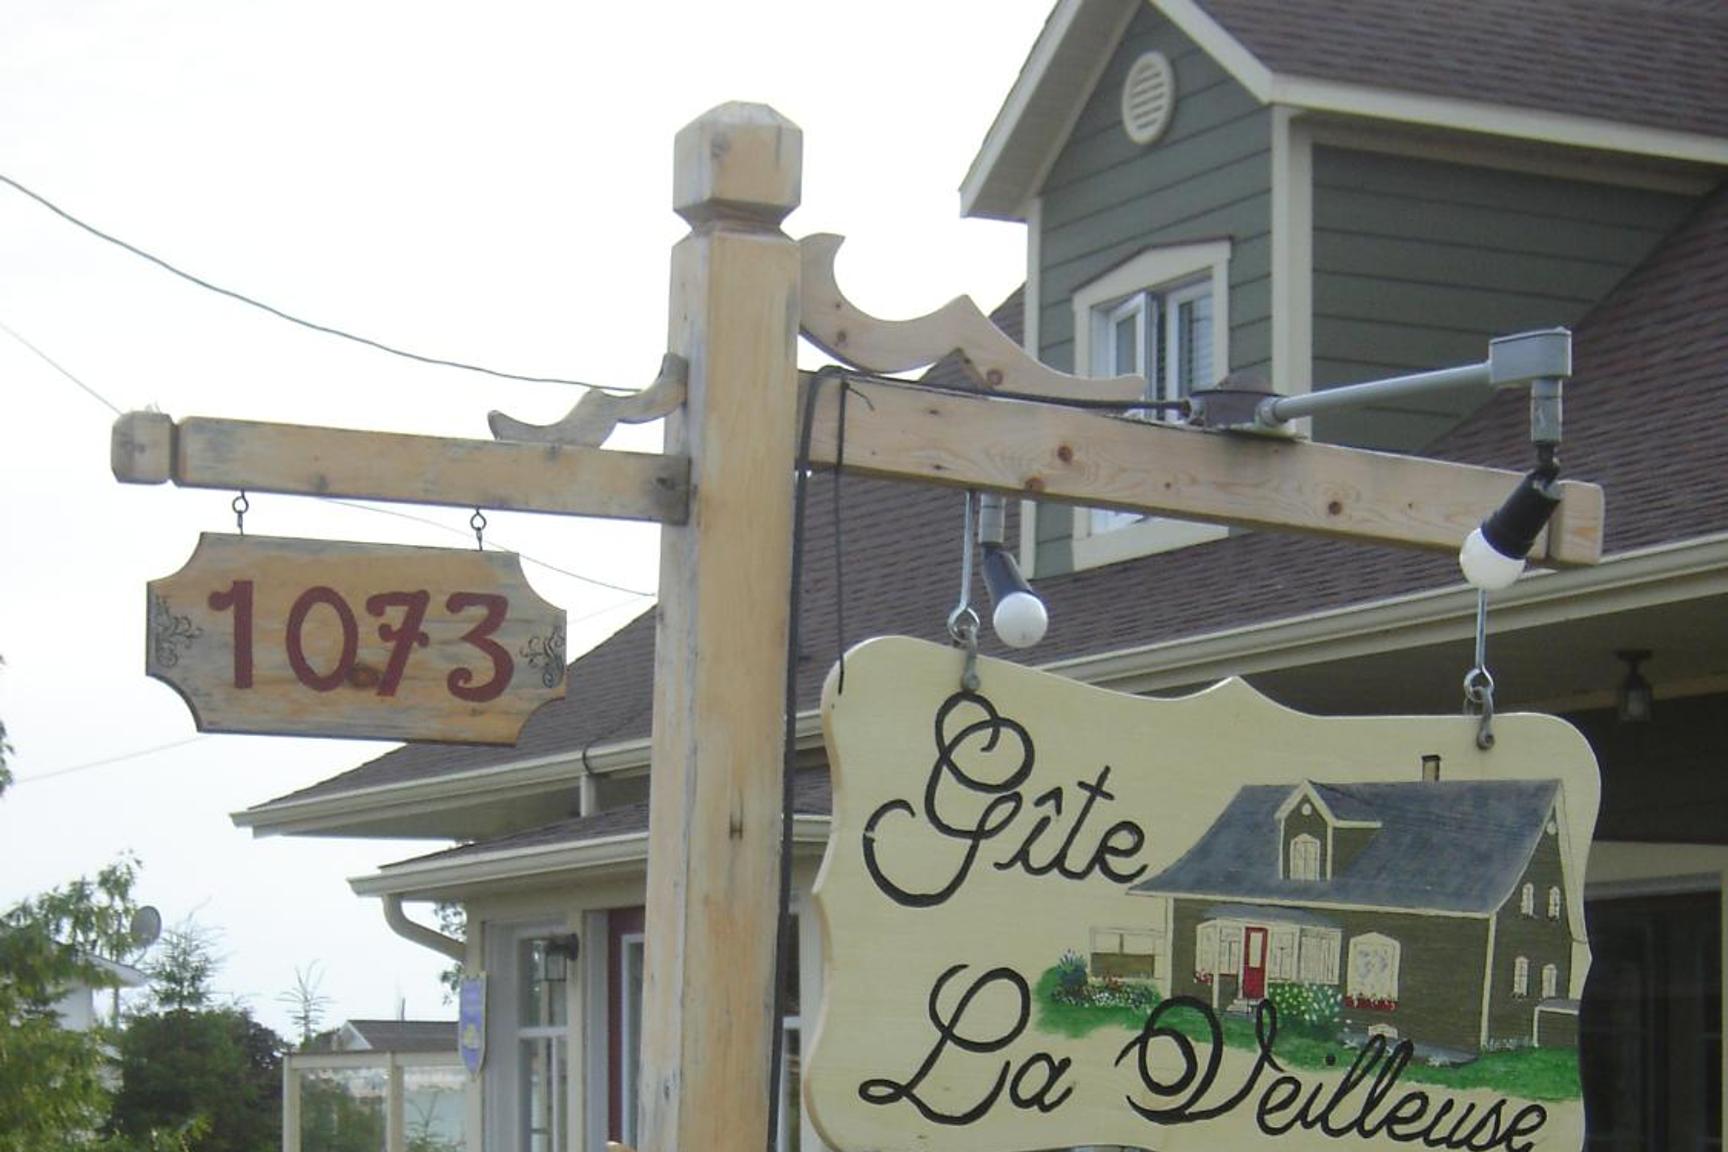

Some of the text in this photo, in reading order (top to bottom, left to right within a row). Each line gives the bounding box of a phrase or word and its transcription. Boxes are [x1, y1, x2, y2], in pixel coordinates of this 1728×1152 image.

[208, 580, 514, 702] 1073
[863, 691, 1148, 906] Gîte
[859, 964, 1074, 1124] La
